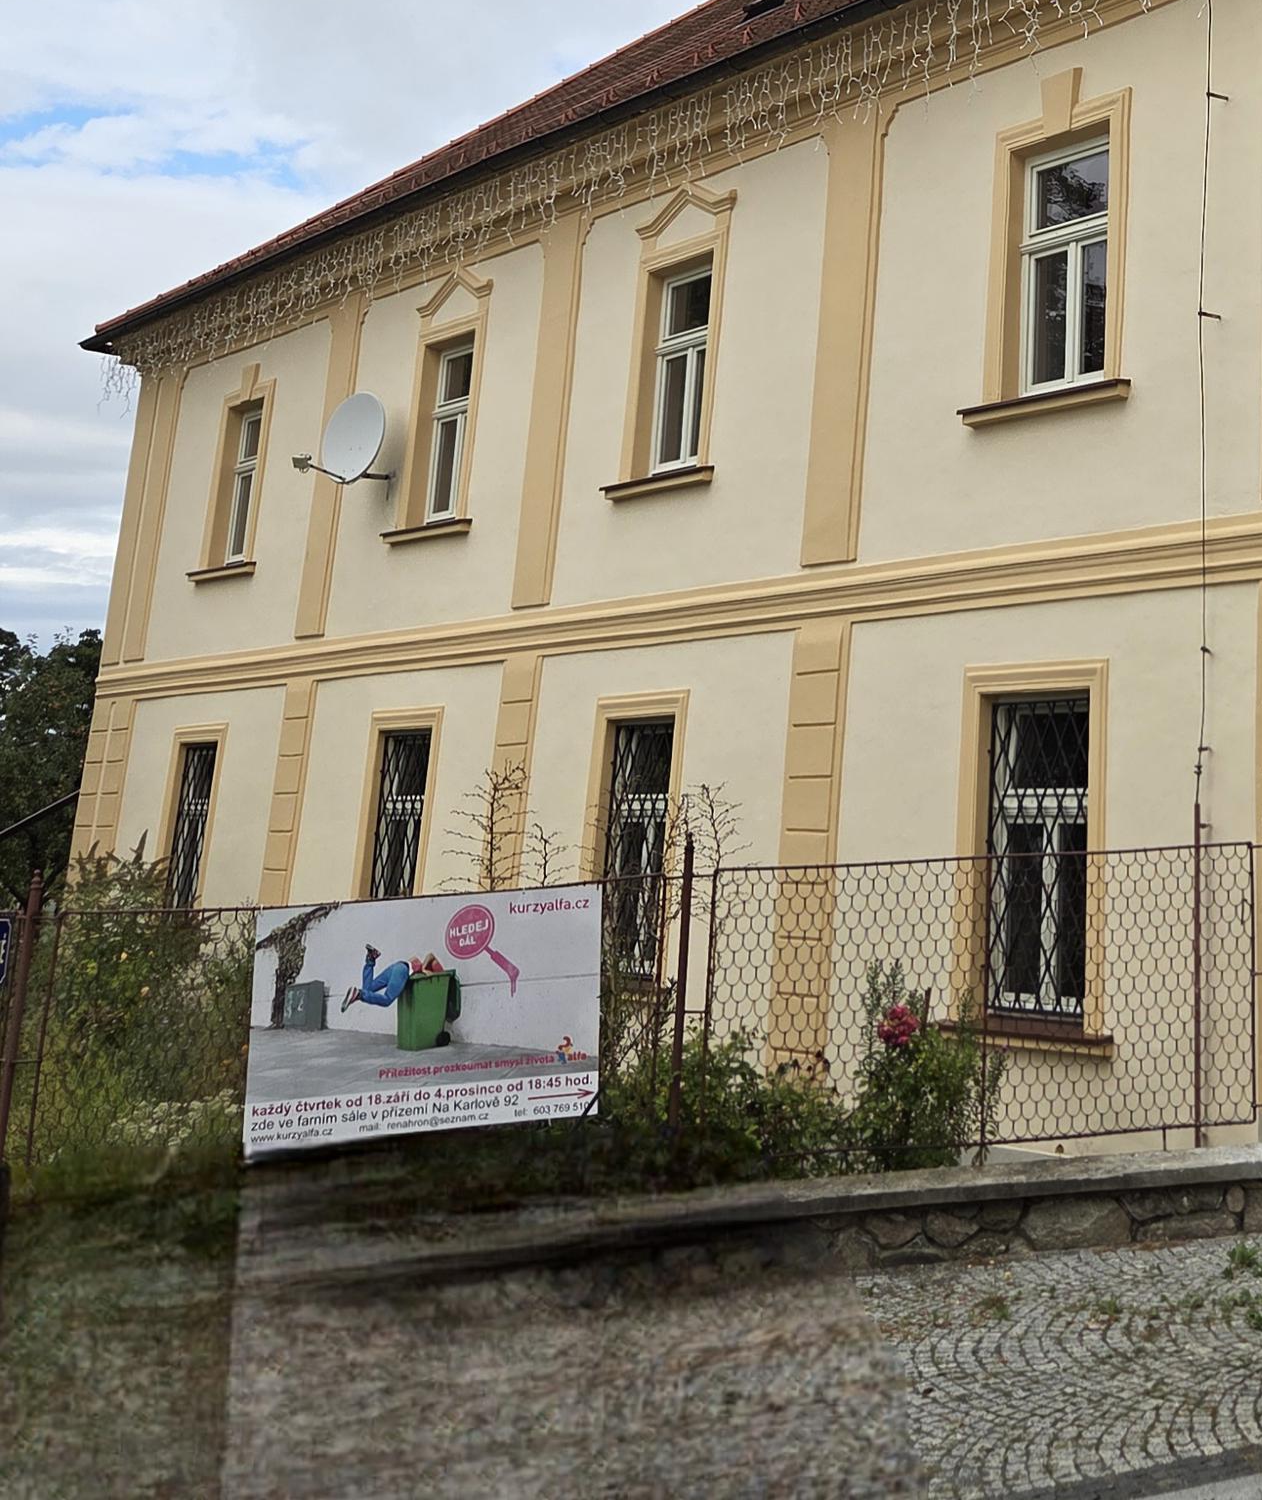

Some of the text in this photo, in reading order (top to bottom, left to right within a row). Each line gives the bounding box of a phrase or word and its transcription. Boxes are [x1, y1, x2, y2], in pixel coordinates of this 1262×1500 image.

[509, 898, 590, 915] kurzyalfa.cz
[450, 919, 489, 938] HLEDEJ
[459, 936, 477, 947] DÁL
[433, 1060, 492, 1075] prozkoumat
[525, 1053, 555, 1065] života
[567, 1051, 588, 1061] alfa
[252, 1073, 593, 1117] každý čtvrtek od 18.září do 4.prosince od 18:45 hod.
[251, 1119, 275, 1131] zde
[278, 1118, 293, 1128] ve
[297, 1112, 338, 1127] farním
[341, 1109, 367, 1122] sále
[371, 1110, 379, 1120] v
[432, 1102, 450, 1114] Na
[453, 1096, 500, 1112] Karlově
[504, 1094, 519, 1107] 92
[251, 1128, 333, 1143] www.kurzyalfa.cz
[533, 1105, 551, 1115] 603
[554, 1103, 570, 1113] 769
[572, 1101, 590, 1112] 510
